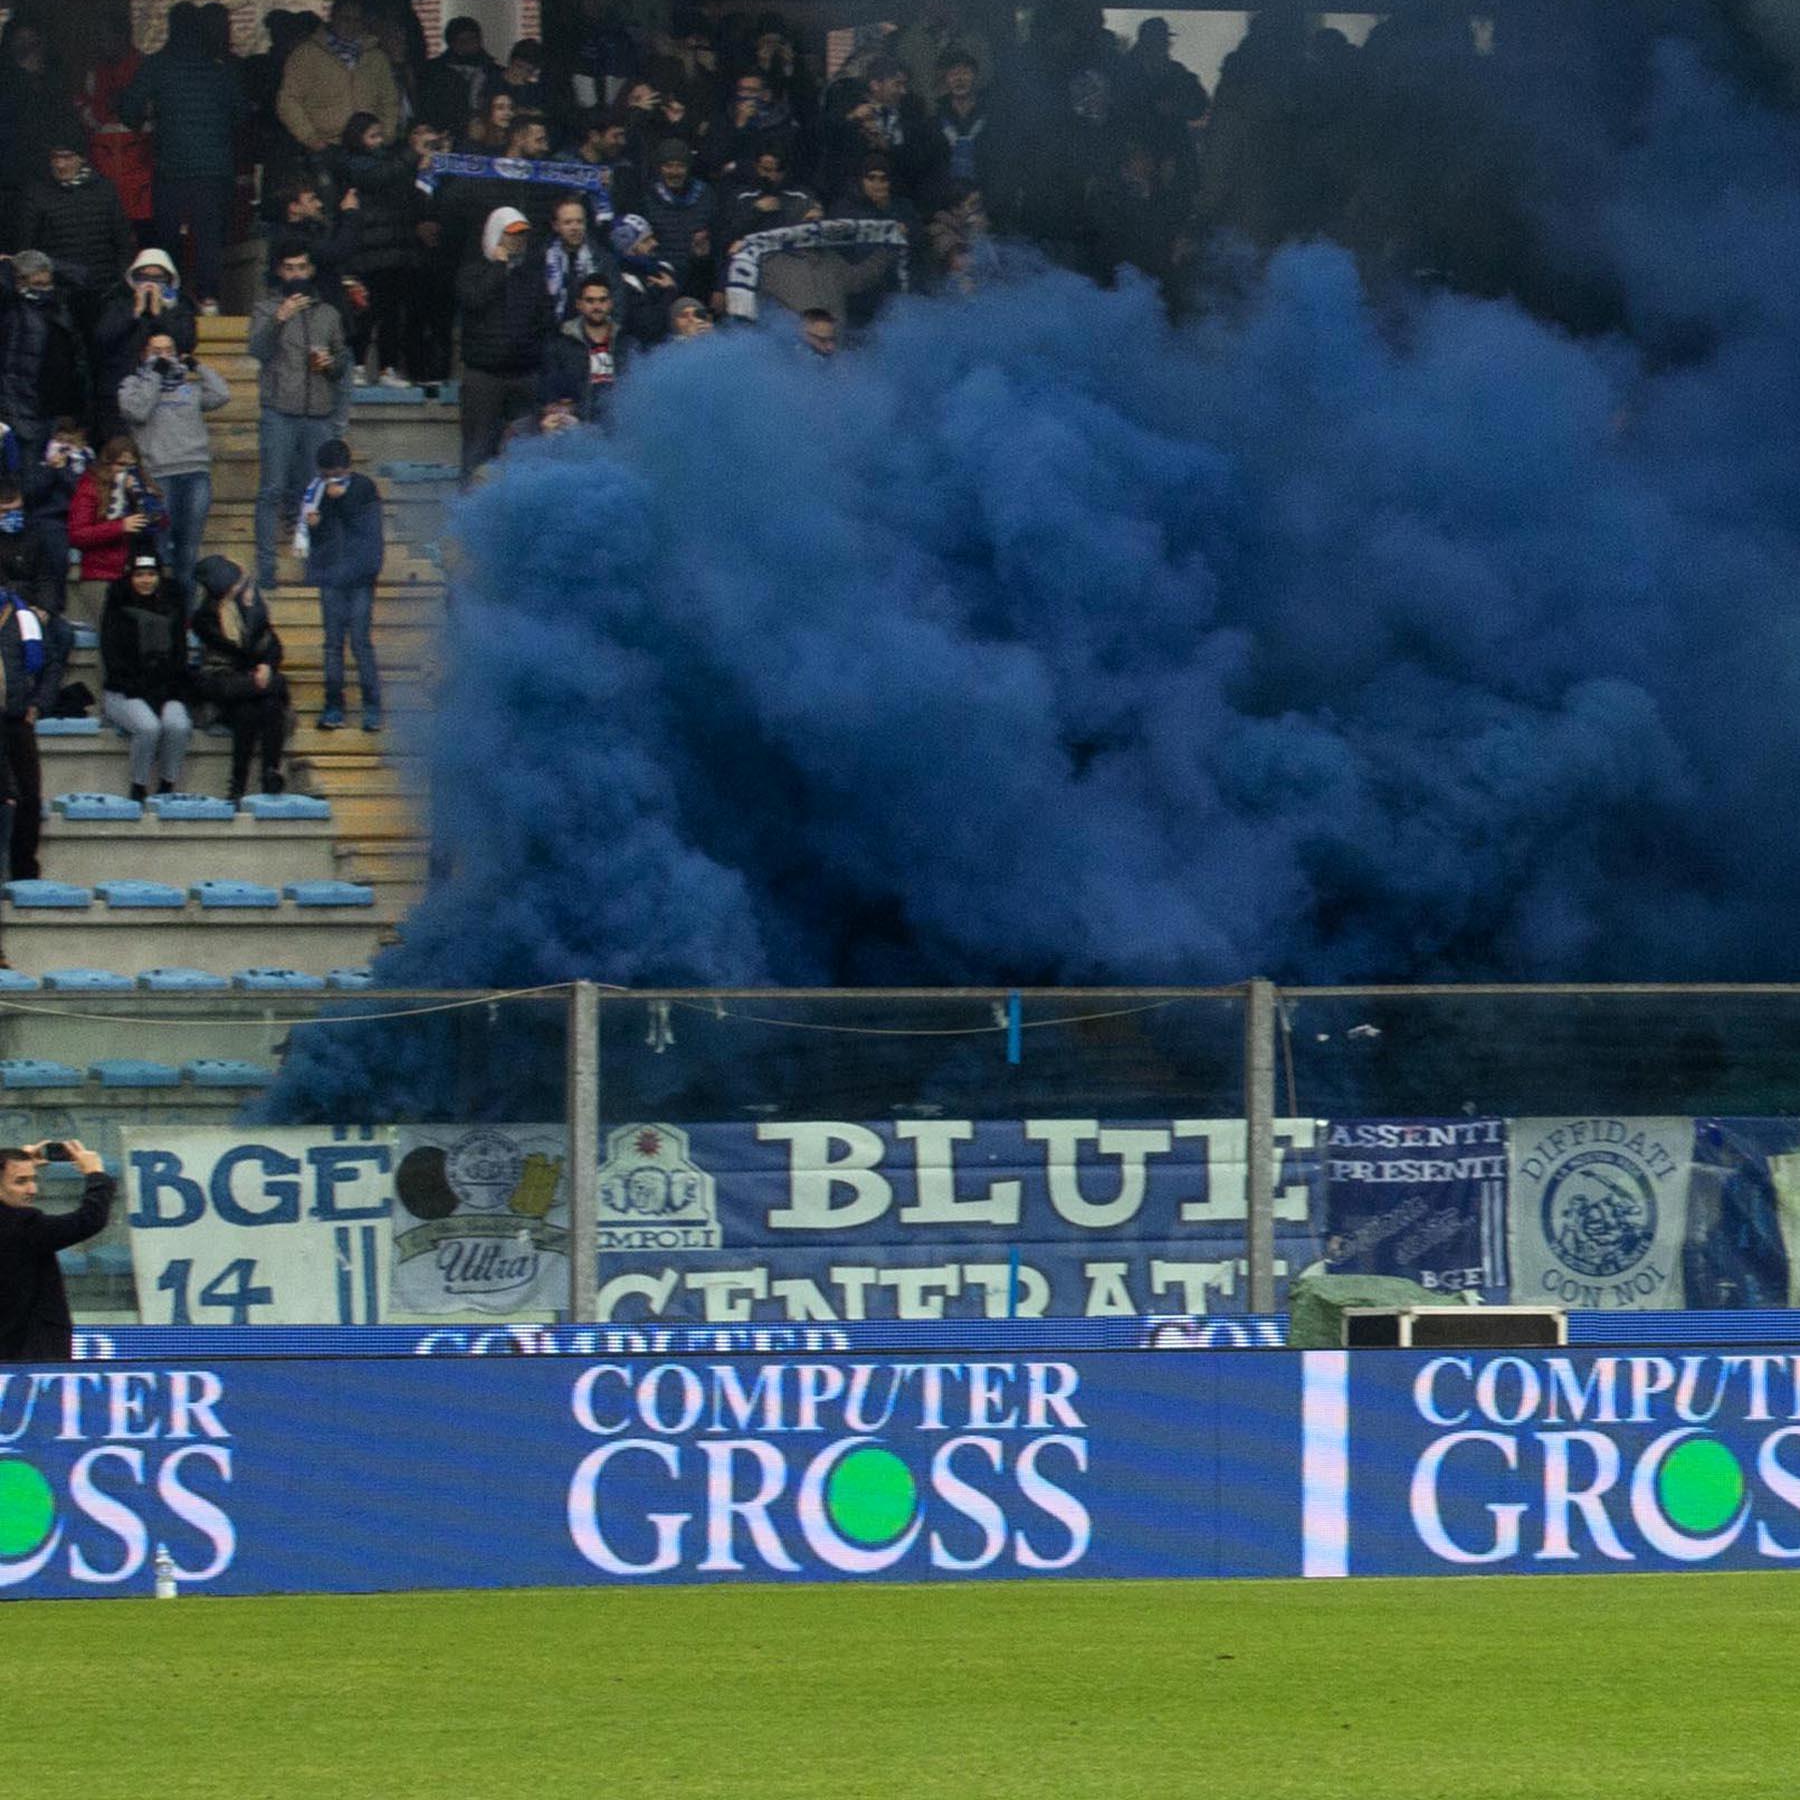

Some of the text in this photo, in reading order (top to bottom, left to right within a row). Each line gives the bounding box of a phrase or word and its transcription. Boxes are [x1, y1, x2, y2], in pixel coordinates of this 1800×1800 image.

[1328, 1120, 1502, 1148] ASSENTI
[1520, 1119, 1678, 1181] DIFFIDATI
[128, 1144, 394, 1229] BGE
[757, 1118, 1315, 1229] BLUE
[1328, 1155, 1507, 1183] PRESENTI
[597, 1229, 716, 1249] MPOLI
[156, 1258, 274, 1325] 14
[572, 1361, 1088, 1435] COMPUTER
[566, 1434, 1092, 1575] GROSS
